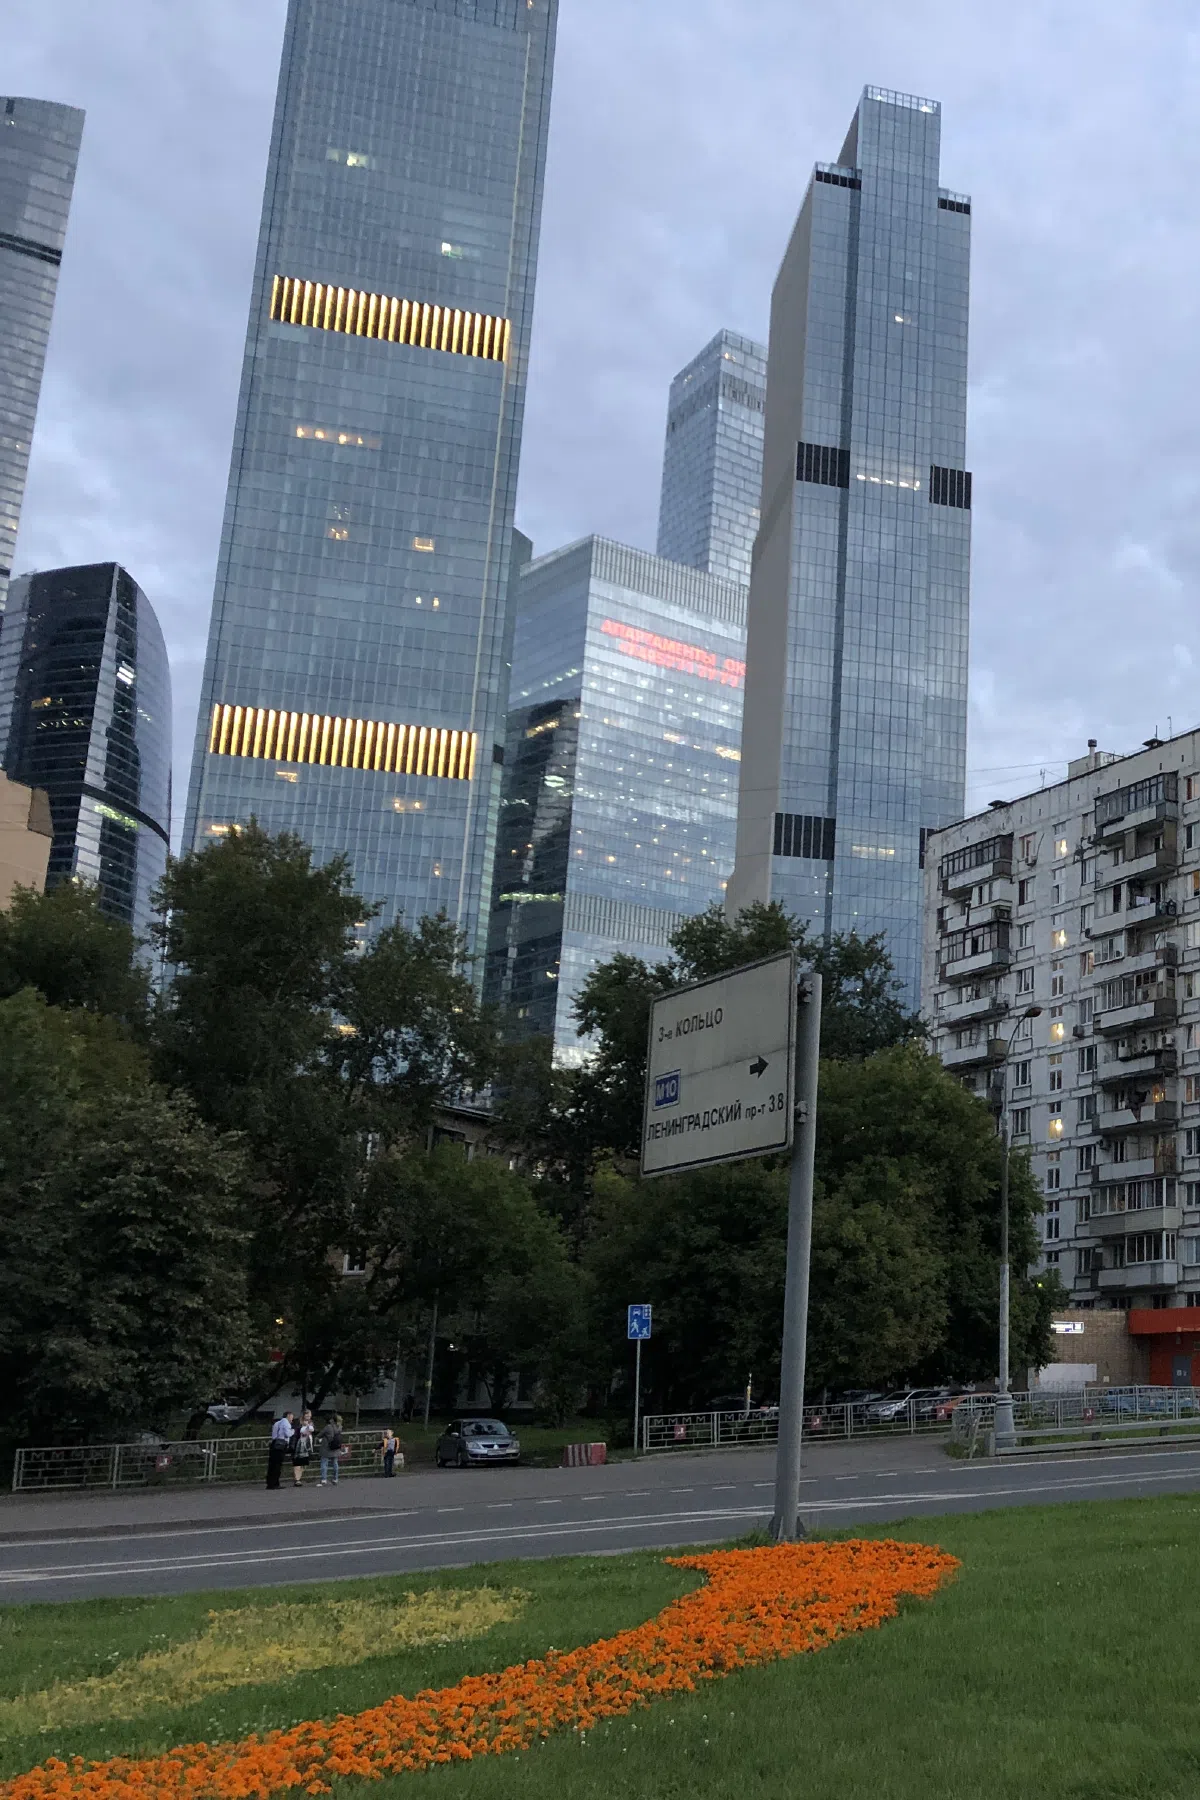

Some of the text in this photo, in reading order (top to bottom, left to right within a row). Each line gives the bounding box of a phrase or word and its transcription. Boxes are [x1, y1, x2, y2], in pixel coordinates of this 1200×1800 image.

[600, 619, 717, 667] АПАРТАМЕНТЫ
[658, 1008, 723, 1042] 3-е КОЛЬЦО
[656, 1080, 677, 1101] М10
[647, 1099, 741, 1141] ЛЕНИНГРАДСКИЙ
[745, 1103, 766, 1120] пр-т
